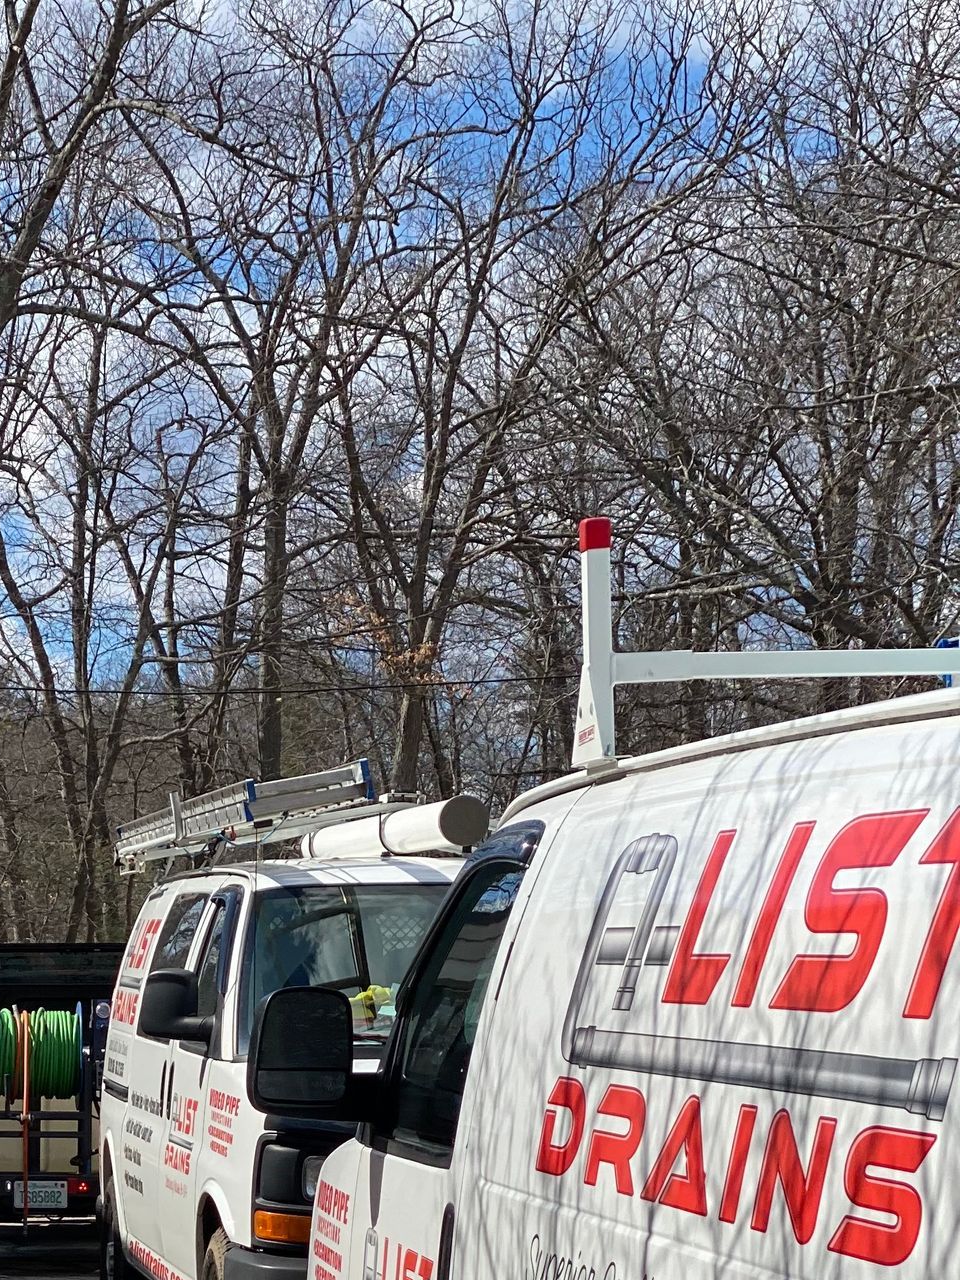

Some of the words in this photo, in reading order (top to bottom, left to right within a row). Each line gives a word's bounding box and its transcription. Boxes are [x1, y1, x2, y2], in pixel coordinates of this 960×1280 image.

[225, 1095, 241, 1117] PIPE
[164, 1144, 191, 1176] DRAINS
[536, 1075, 937, 1266] DRAINS
[332, 1188, 350, 1225] PIPE
[315, 1238, 342, 1273] EXCAVATION
